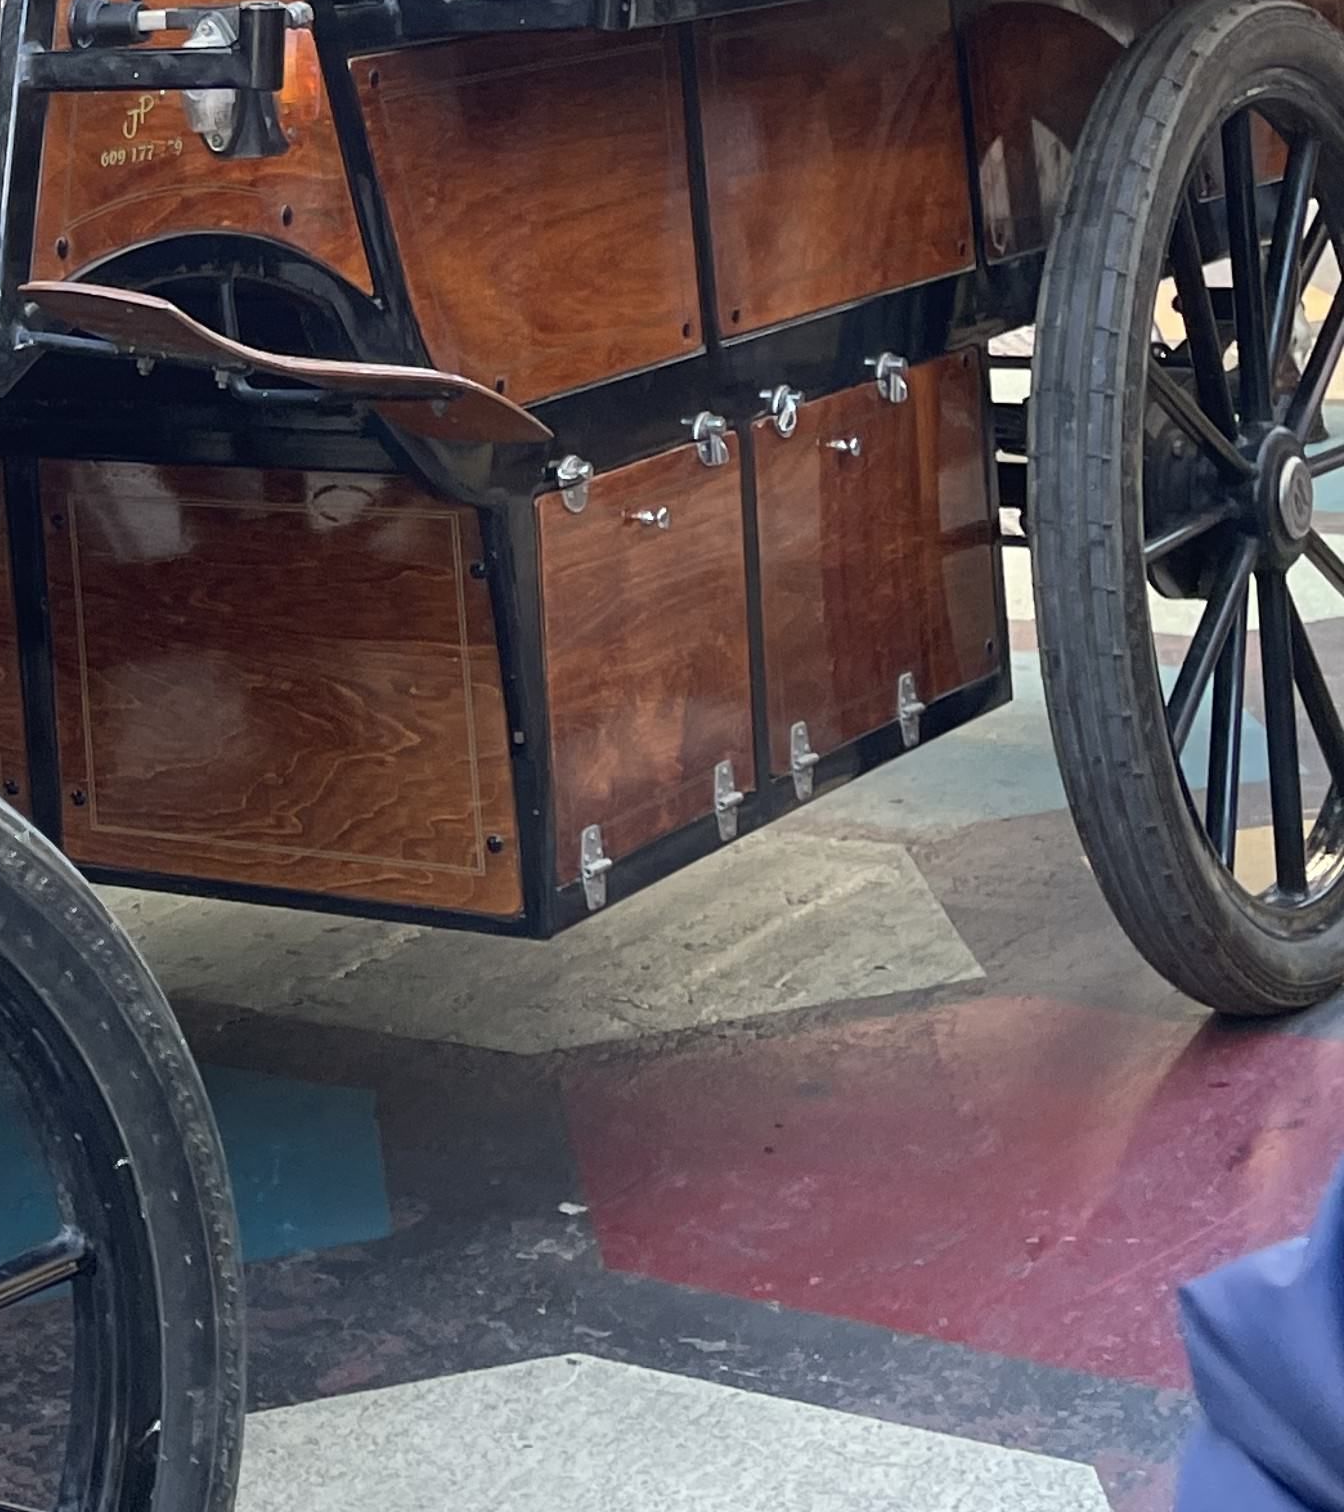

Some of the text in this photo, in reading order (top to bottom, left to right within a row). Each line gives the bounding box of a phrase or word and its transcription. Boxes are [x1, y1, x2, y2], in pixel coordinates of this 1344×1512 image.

[123, 94, 155, 139] JP
[100, 149, 126, 168] 609
[131, 143, 155, 164] 177
